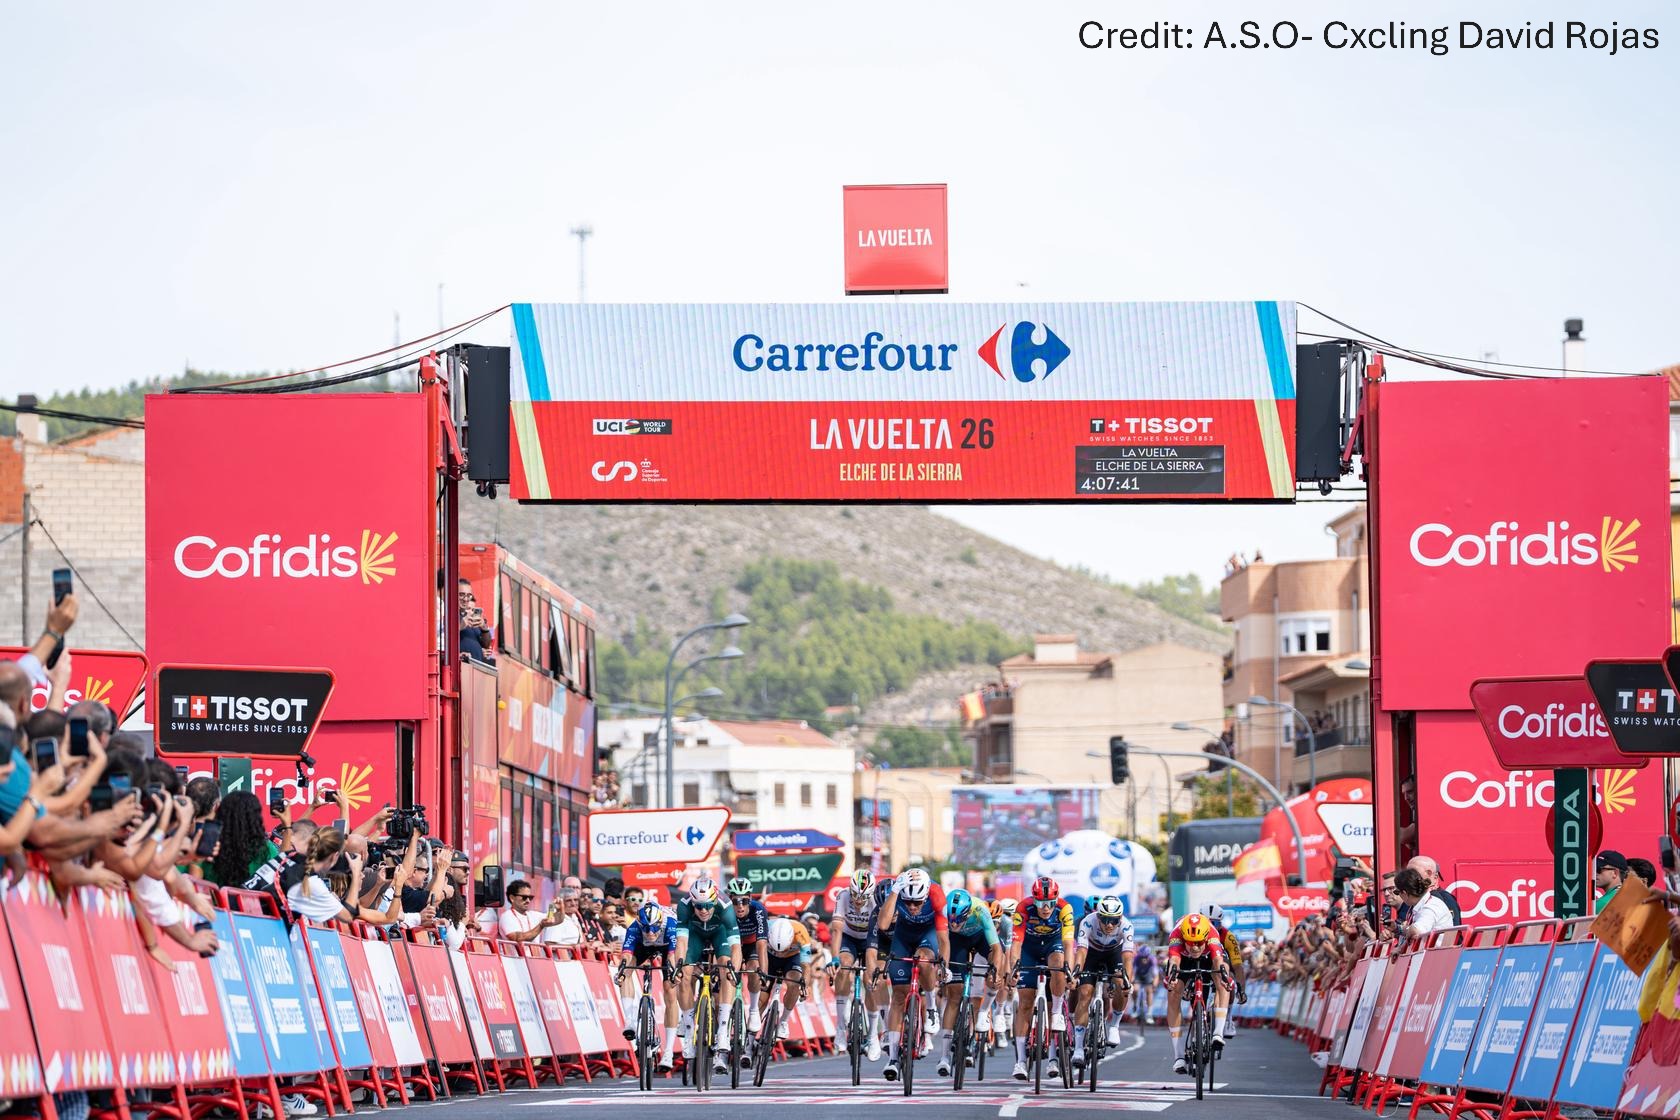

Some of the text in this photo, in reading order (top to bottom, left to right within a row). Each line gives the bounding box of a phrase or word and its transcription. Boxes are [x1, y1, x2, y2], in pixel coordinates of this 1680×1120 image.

[858, 228, 933, 248] LA VUELTA
[733, 331, 958, 372] Carrefour
[596, 421, 623, 433] UCI
[1125, 417, 1213, 433] TISSOT
[811, 418, 994, 450] LA VUELTA 26
[1122, 448, 1178, 457] LA VUELTA
[840, 462, 963, 480] ELCHE DE LA SIERRA
[1095, 461, 1205, 471] ELCHE DE LA SIERRA
[1080, 477, 1140, 491] 4:07:41
[1409, 520, 1599, 567] Cofidis
[174, 533, 358, 580] Cofidis
[210, 695, 308, 722] TISSOT
[171, 722, 200, 731] SWISS
[205, 723, 249, 732] WATCHES
[253, 724, 283, 733] SINCE
[1613, 716, 1648, 725] SWISS
[596, 830, 669, 846] Carrefour
[765, 834, 808, 847] helvetia
[748, 867, 822, 883] SKODA
